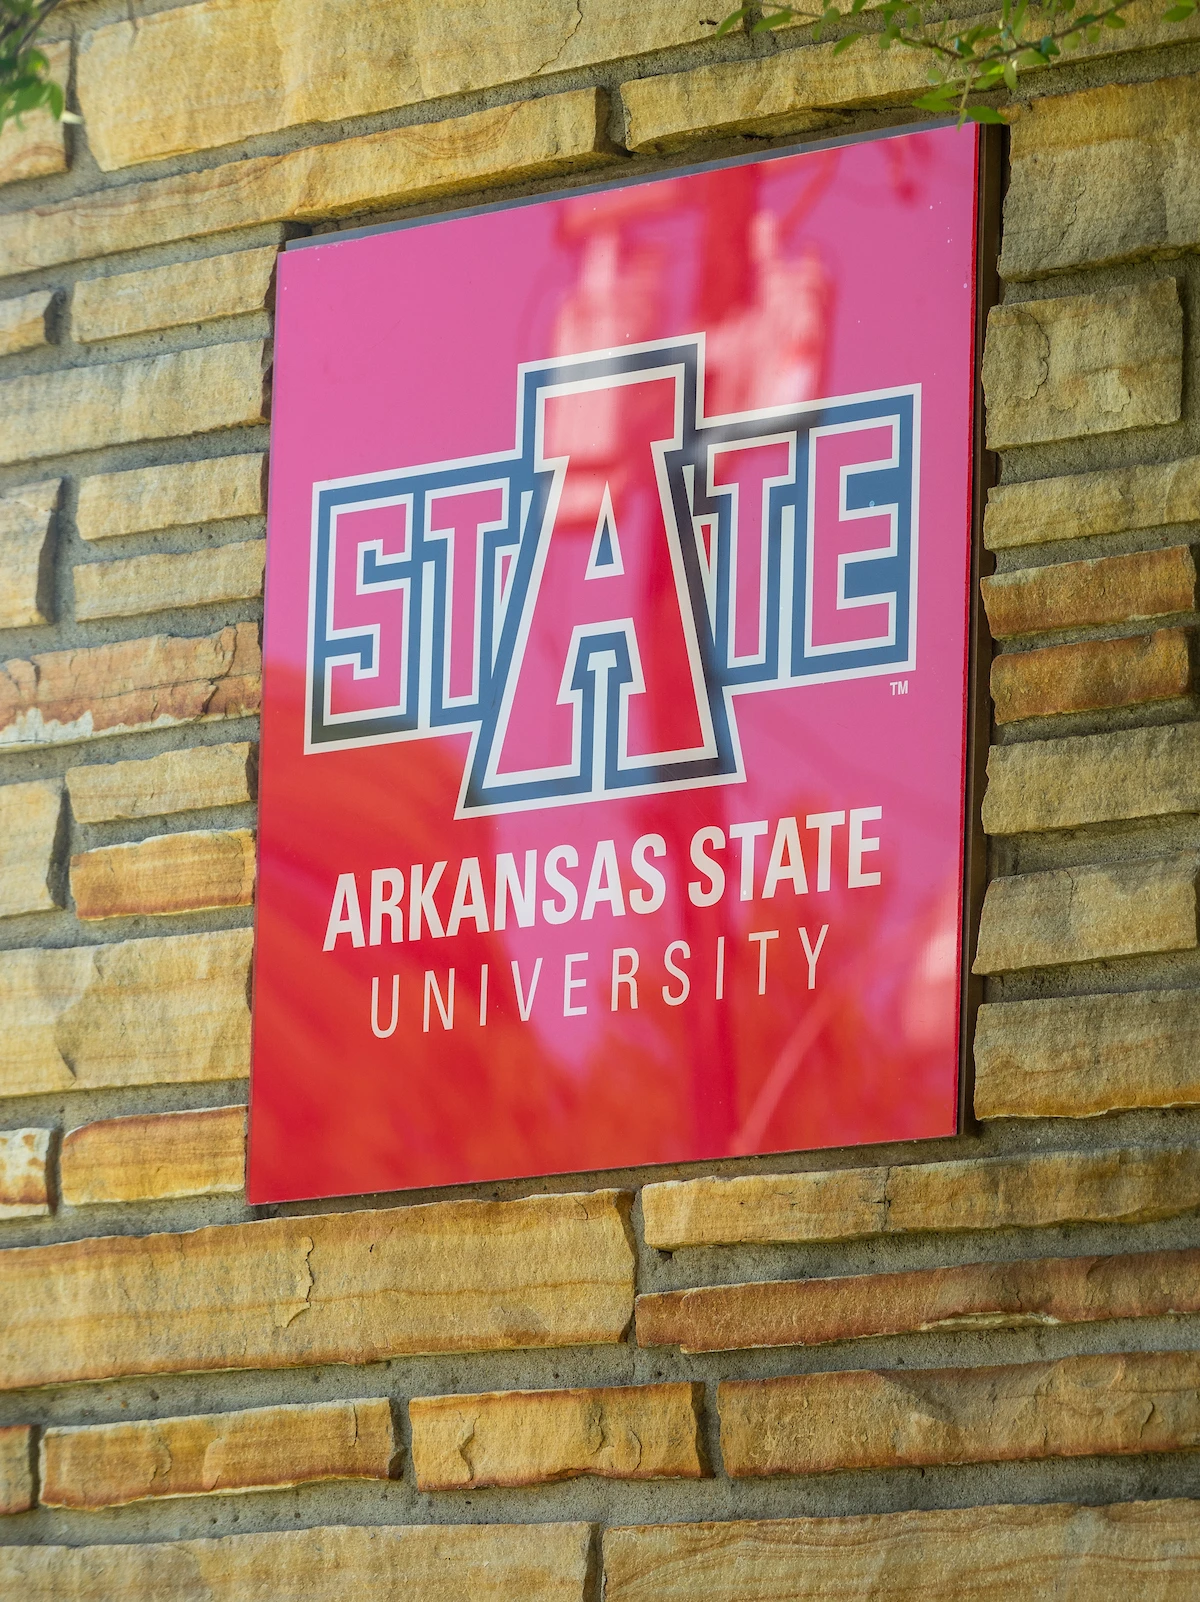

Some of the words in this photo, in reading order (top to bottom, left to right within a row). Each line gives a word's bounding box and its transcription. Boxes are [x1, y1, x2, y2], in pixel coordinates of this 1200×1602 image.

[304, 332, 922, 820] STATE
[889, 679, 909, 696] TM
[322, 833, 667, 952] ARKANSAS
[688, 806, 883, 908] STATE
[370, 924, 830, 1039] UNIVERSITY
